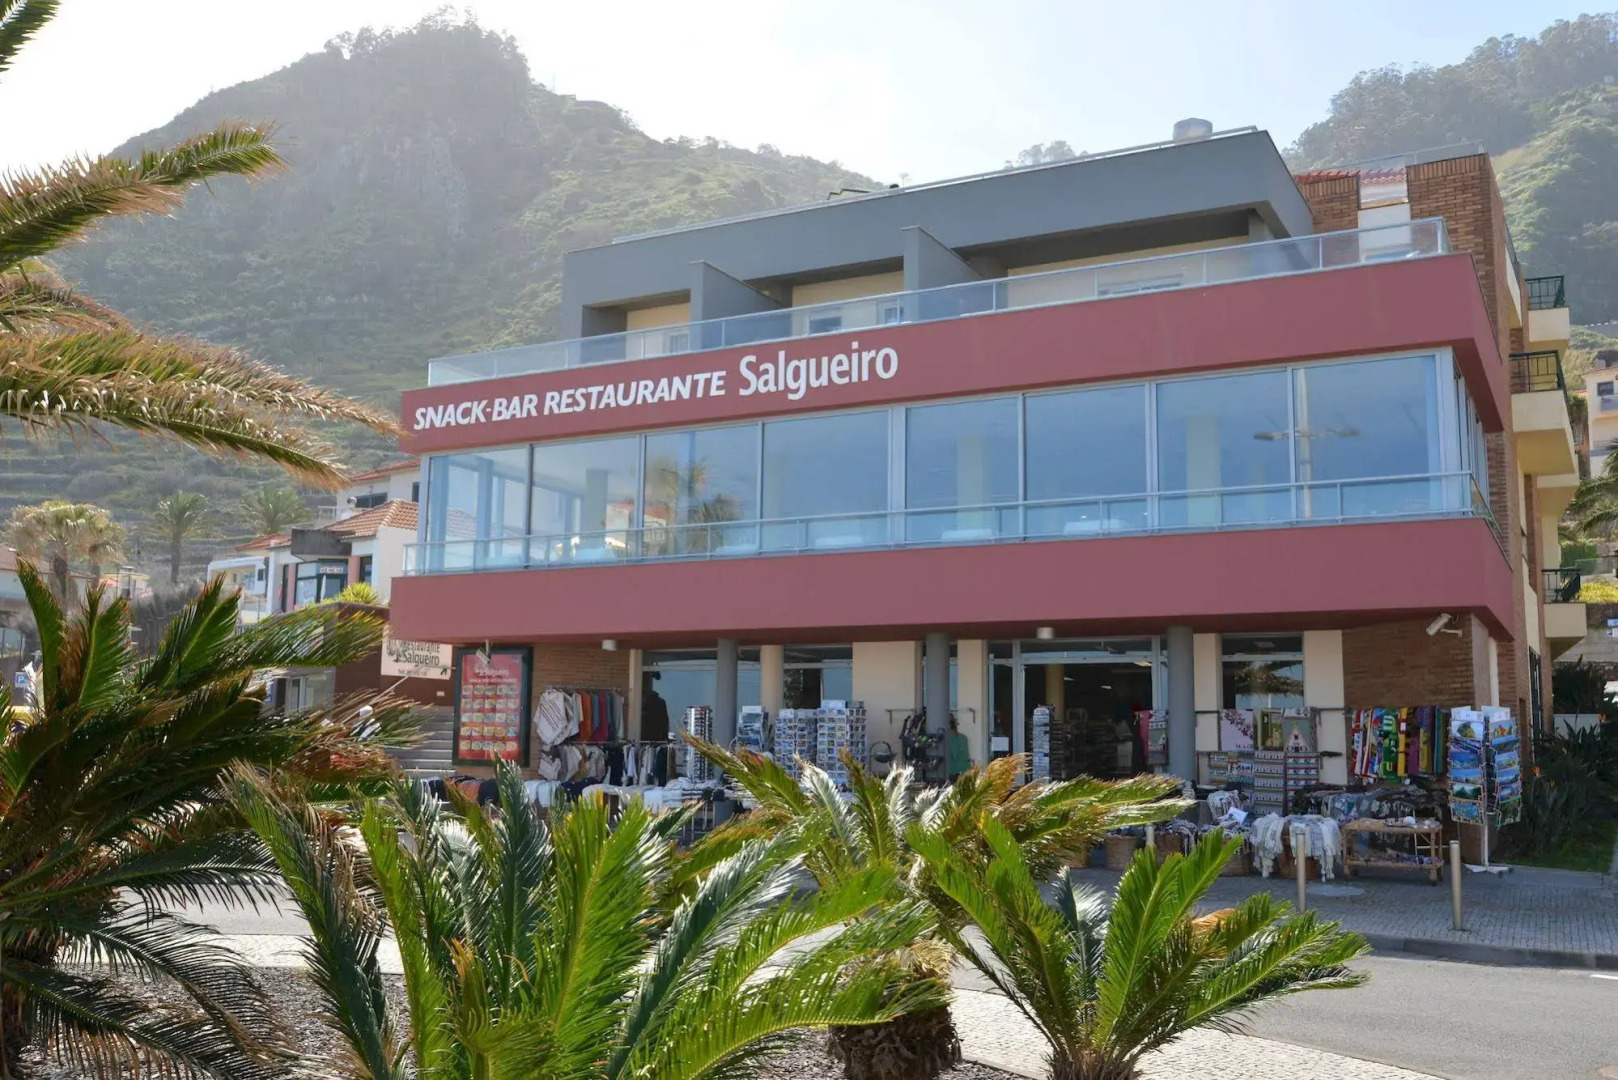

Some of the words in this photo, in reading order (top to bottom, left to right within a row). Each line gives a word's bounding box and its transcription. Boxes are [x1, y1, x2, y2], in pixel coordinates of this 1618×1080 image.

[413, 393, 539, 431] SNACK-BAR
[543, 370, 727, 417] RESTAURANTE
[738, 341, 899, 401] Salgueiro
[402, 651, 440, 667] Salgueiro
